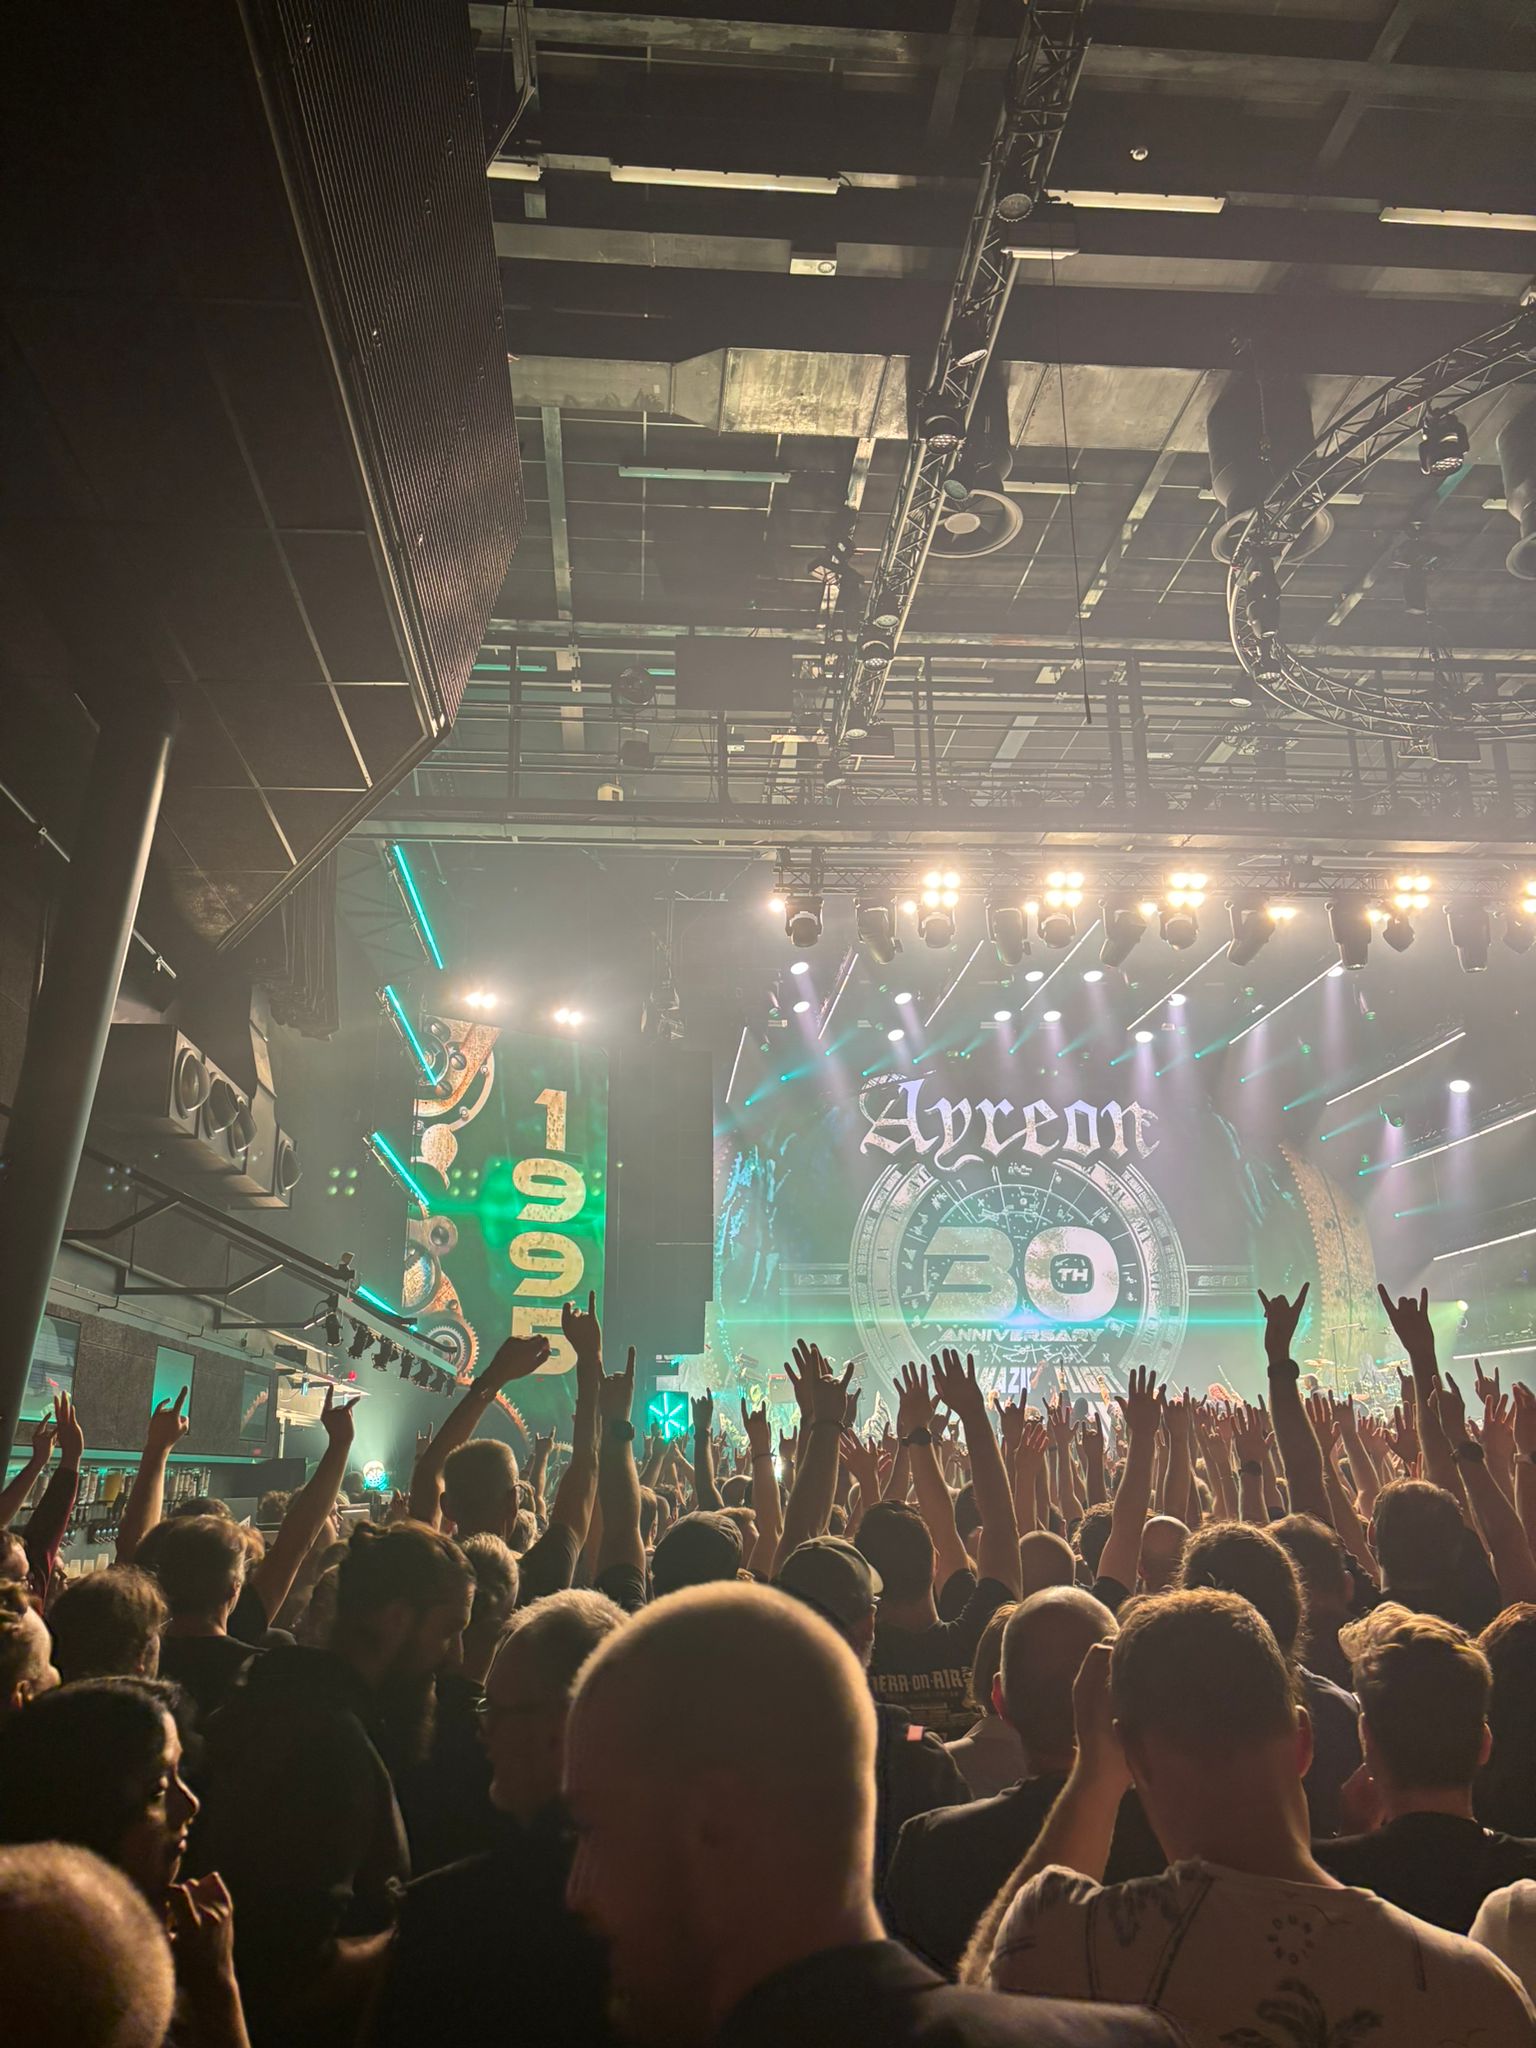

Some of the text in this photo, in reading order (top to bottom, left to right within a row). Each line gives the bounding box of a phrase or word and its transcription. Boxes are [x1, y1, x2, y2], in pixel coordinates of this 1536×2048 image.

[859, 1071, 1160, 1171] Ayreon
[509, 1088, 587, 1376] 1995
[922, 1226, 1120, 1322] 30
[1057, 1267, 1090, 1282] TH
[938, 1328, 1105, 1342] ANNIVERSARY
